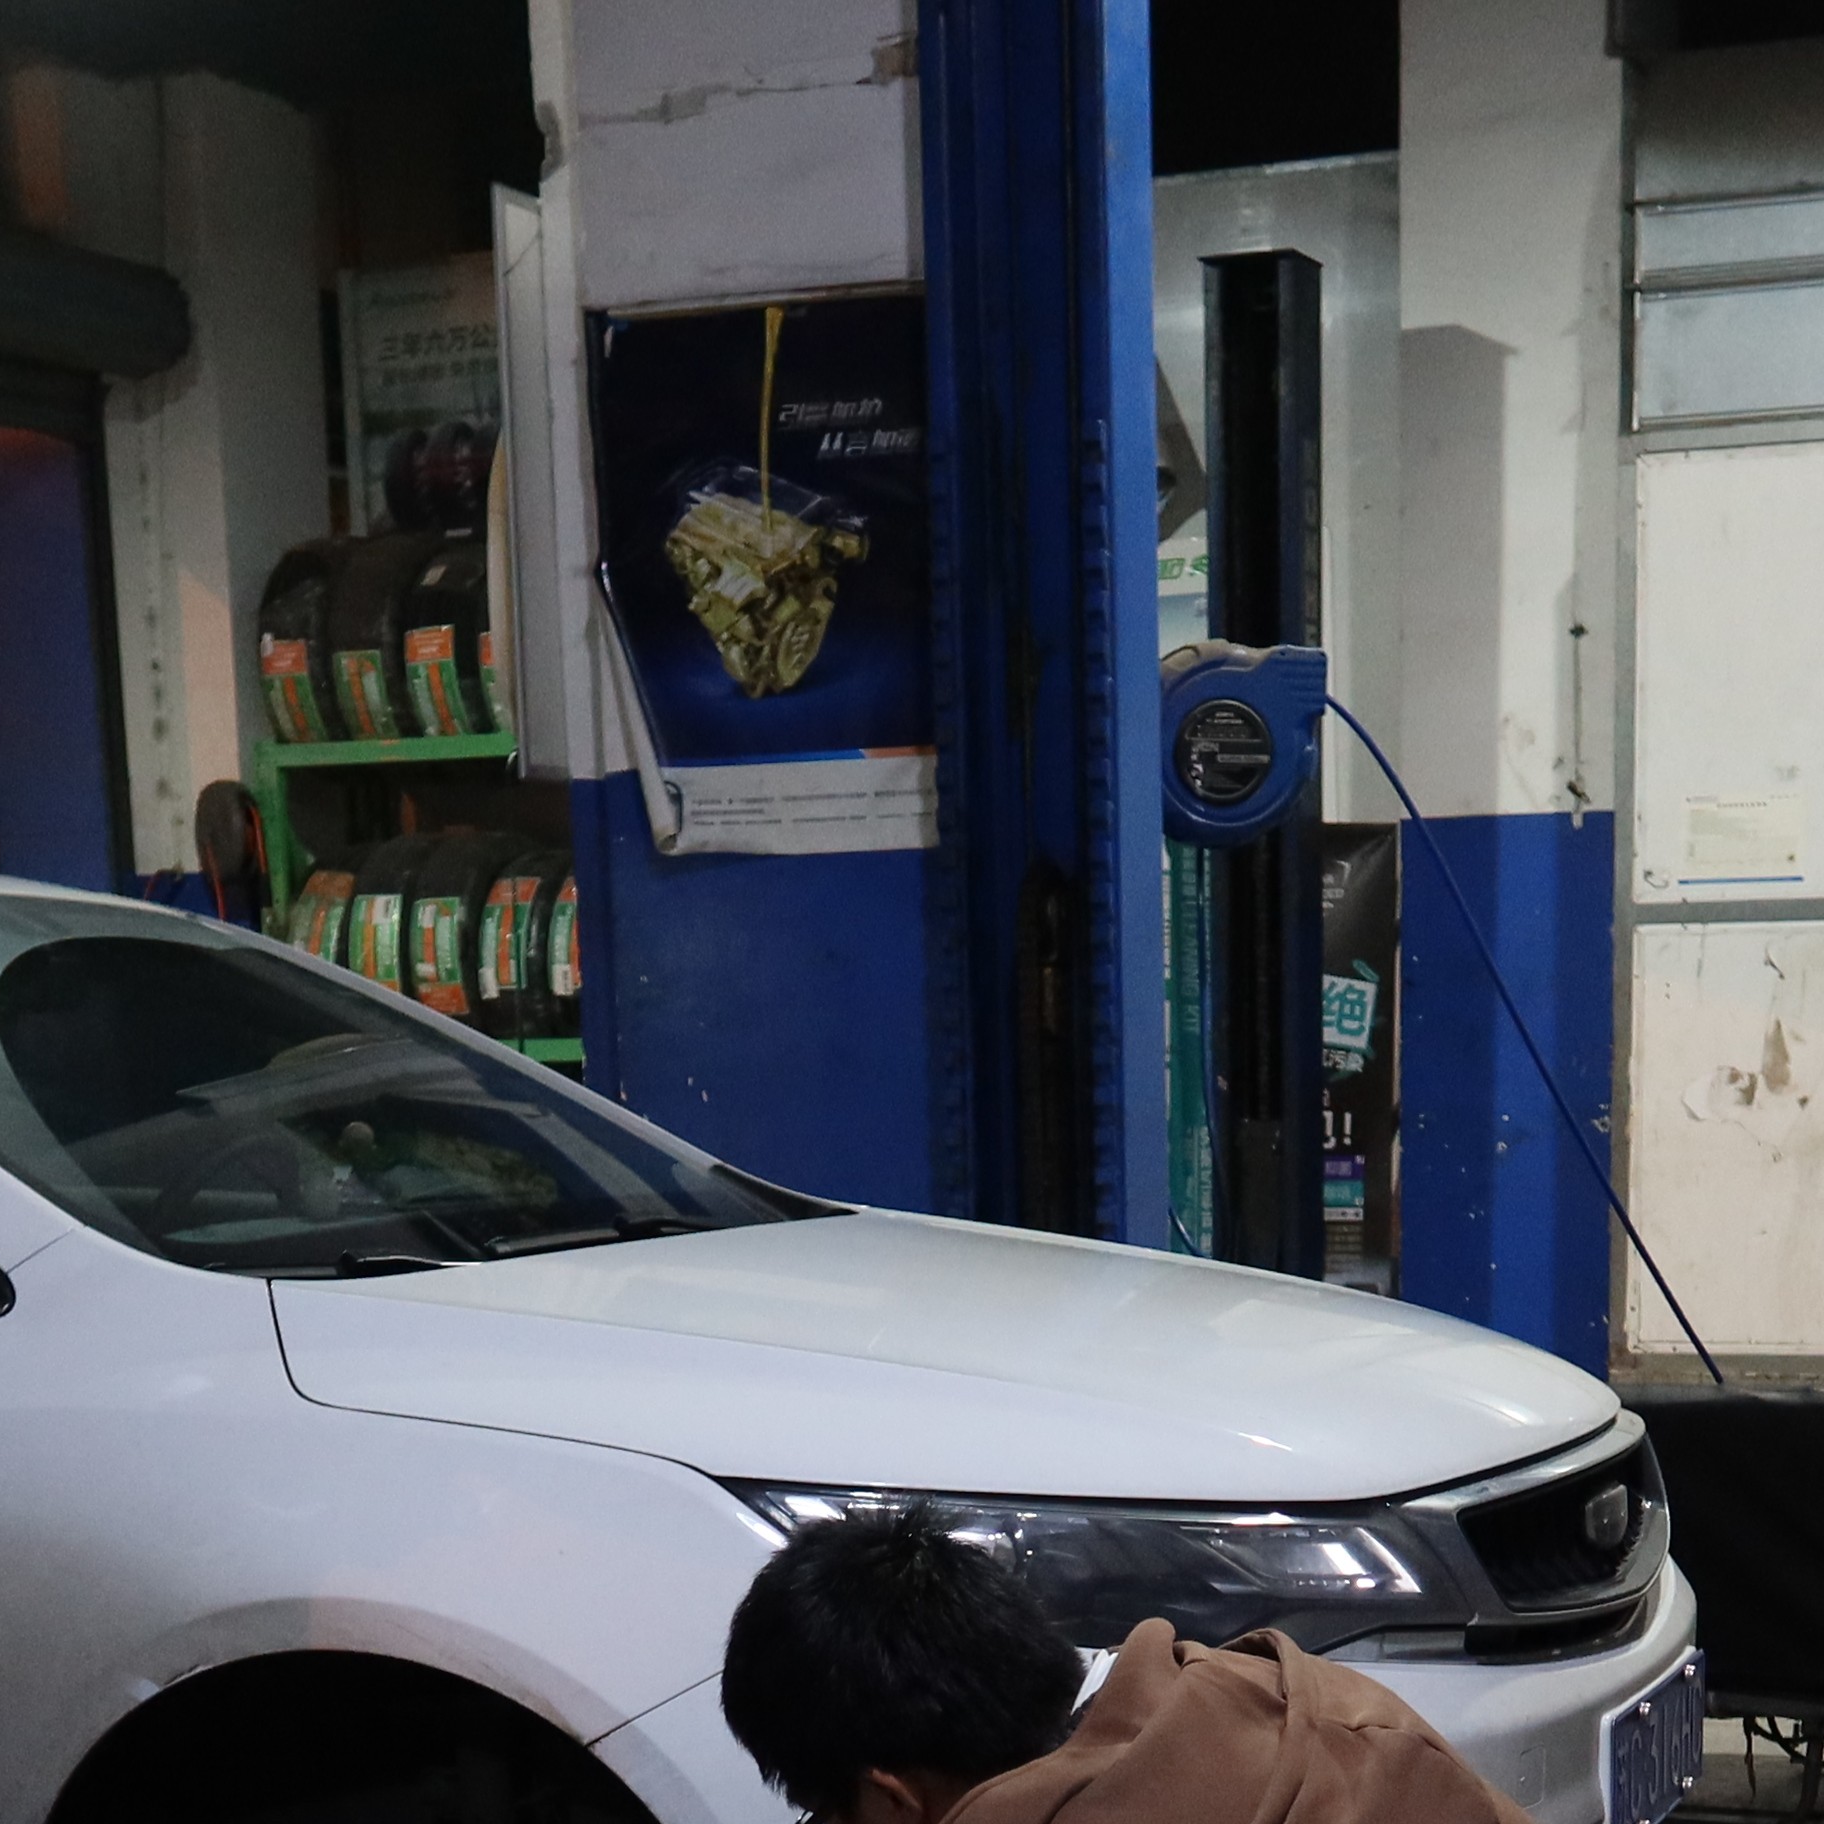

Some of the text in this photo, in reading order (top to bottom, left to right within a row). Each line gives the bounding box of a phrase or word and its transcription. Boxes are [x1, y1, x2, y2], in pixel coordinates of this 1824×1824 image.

[378, 323, 497, 362] 三年六万公
